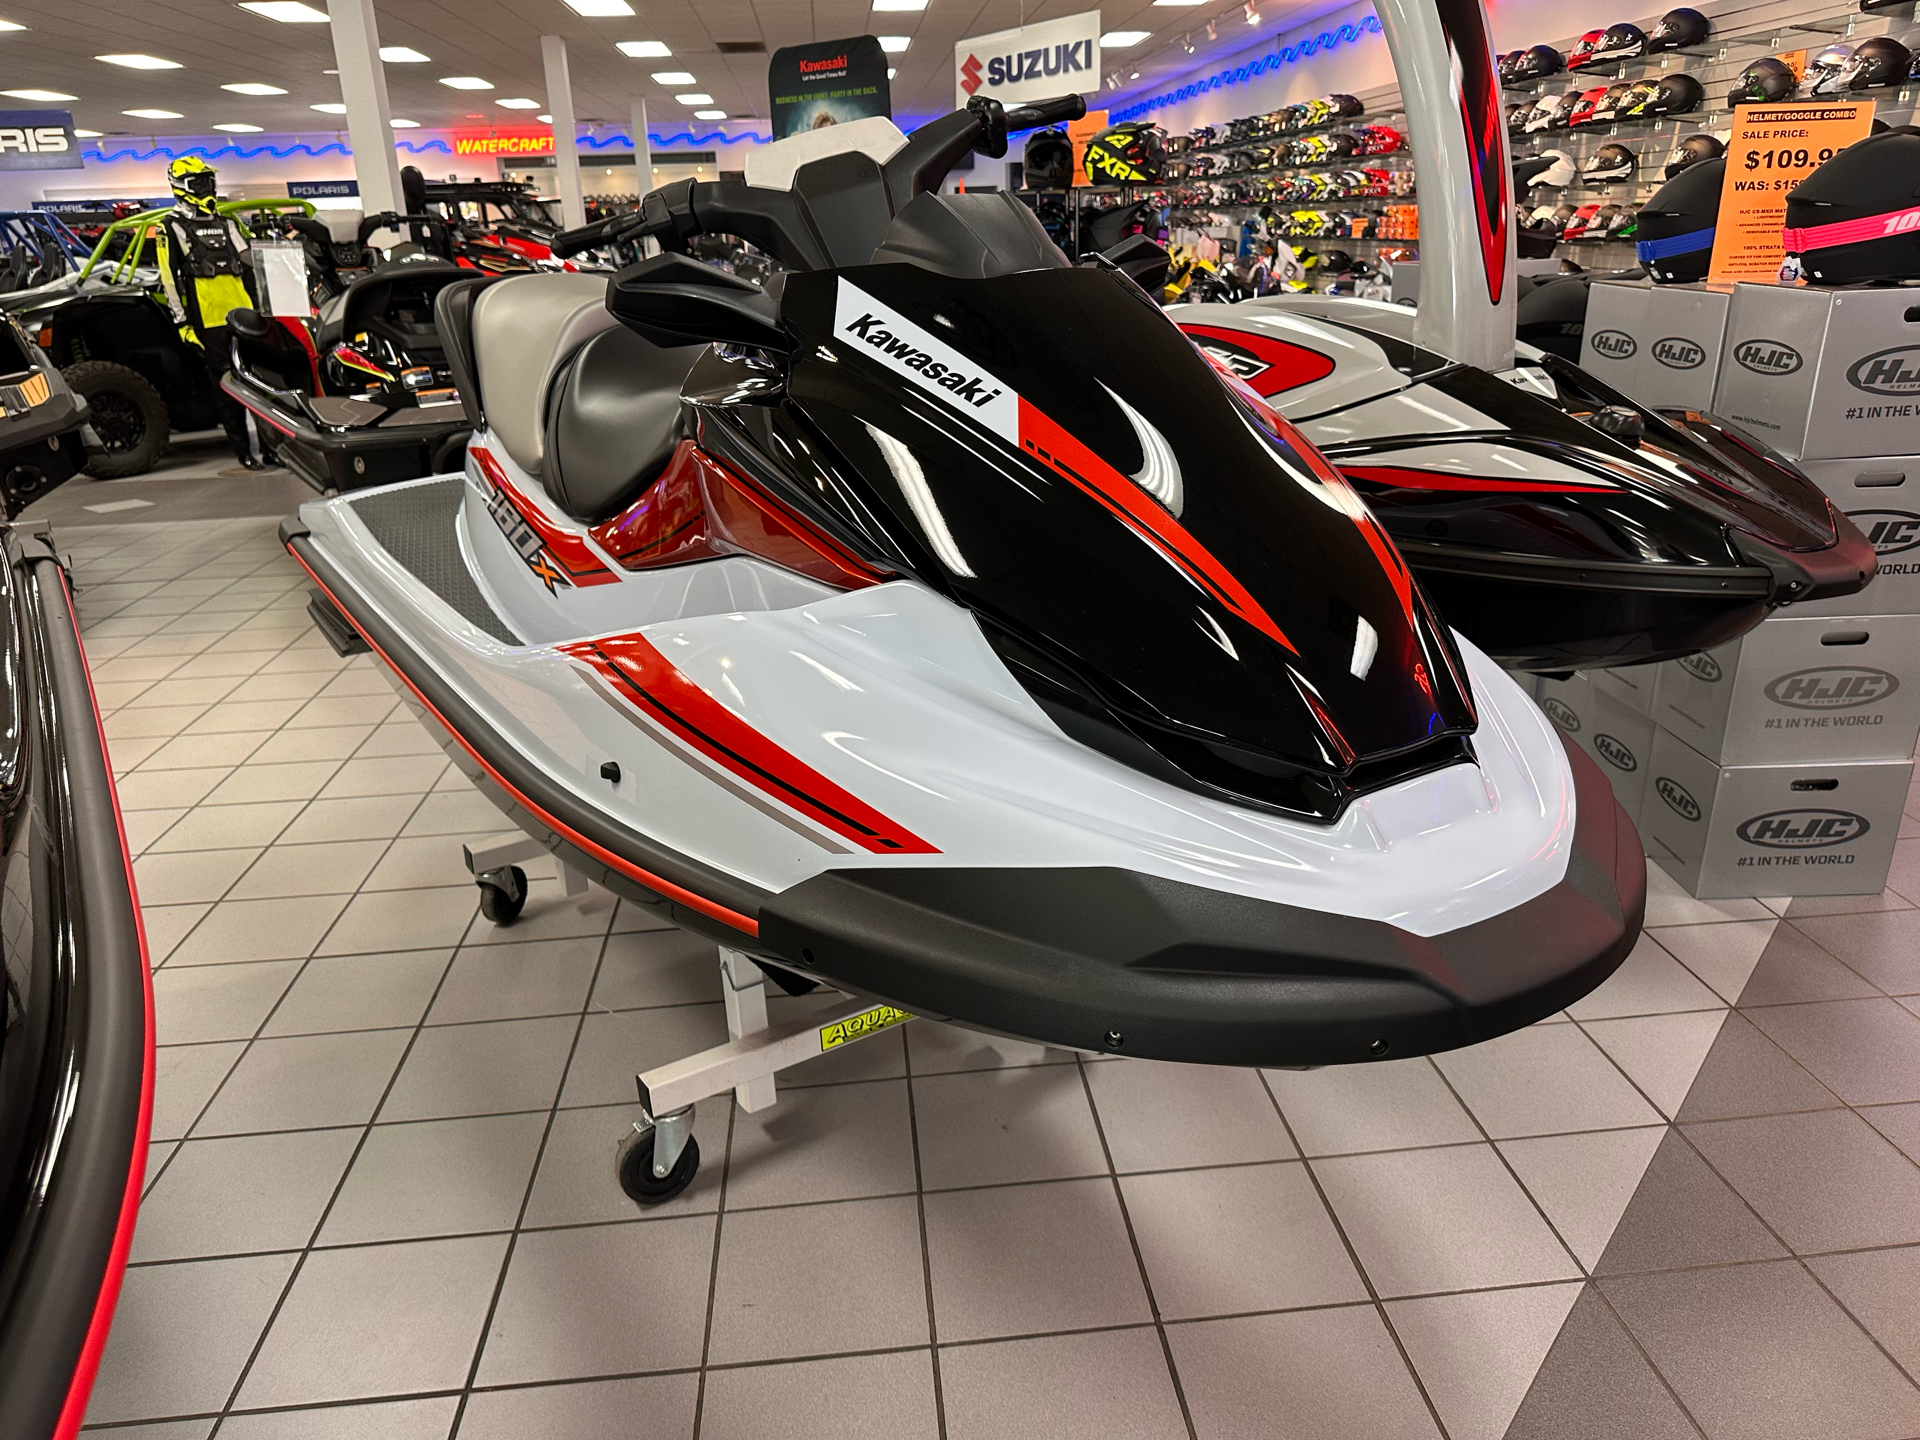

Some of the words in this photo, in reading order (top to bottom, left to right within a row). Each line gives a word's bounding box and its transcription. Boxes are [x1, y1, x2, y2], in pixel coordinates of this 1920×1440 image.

[799, 55, 848, 73] Kawasaki
[988, 39, 1092, 86] SUZUKI
[1747, 111, 1822, 122] HELMET/GOGGLE
[1823, 110, 1857, 120] COMBO
[1742, 131, 1770, 140] SALE
[1773, 129, 1809, 139] PRICE:
[456, 136, 555, 155] WATERCRAFT
[1087, 145, 1132, 181] FXR
[1744, 148, 1849, 172] $109.9
[292, 184, 350, 196] POLARIS
[1735, 181, 1770, 192] WAS:
[1773, 180, 1806, 191] $15
[38, 204, 86, 213] POLARIS
[1596, 335, 1632, 355] HJC
[1657, 343, 1700, 364] HJC
[845, 312, 1003, 408] Kawasaki
[1740, 345, 1795, 369] HJC
[1845, 407, 1864, 419] #1
[1866, 406, 1882, 418] IN
[1885, 405, 1912, 417] THE
[1731, 414, 1781, 431] www.hjchelmets.com
[1780, 675, 1886, 700] HJC
[1549, 702, 1577, 728] HJC
[1765, 719, 1783, 729] #1
[1785, 718, 1801, 728] IN
[1802, 717, 1831, 728] THE
[1833, 715, 1884, 727] WORLD
[1599, 742, 1632, 768] HJC
[1660, 782, 1698, 817] HJC
[1752, 818, 1855, 840] HJC
[1736, 857, 1755, 867] #1
[1757, 856, 1773, 866] IN
[1773, 855, 1801, 866] THE
[1804, 854, 1856, 865] WORLD
